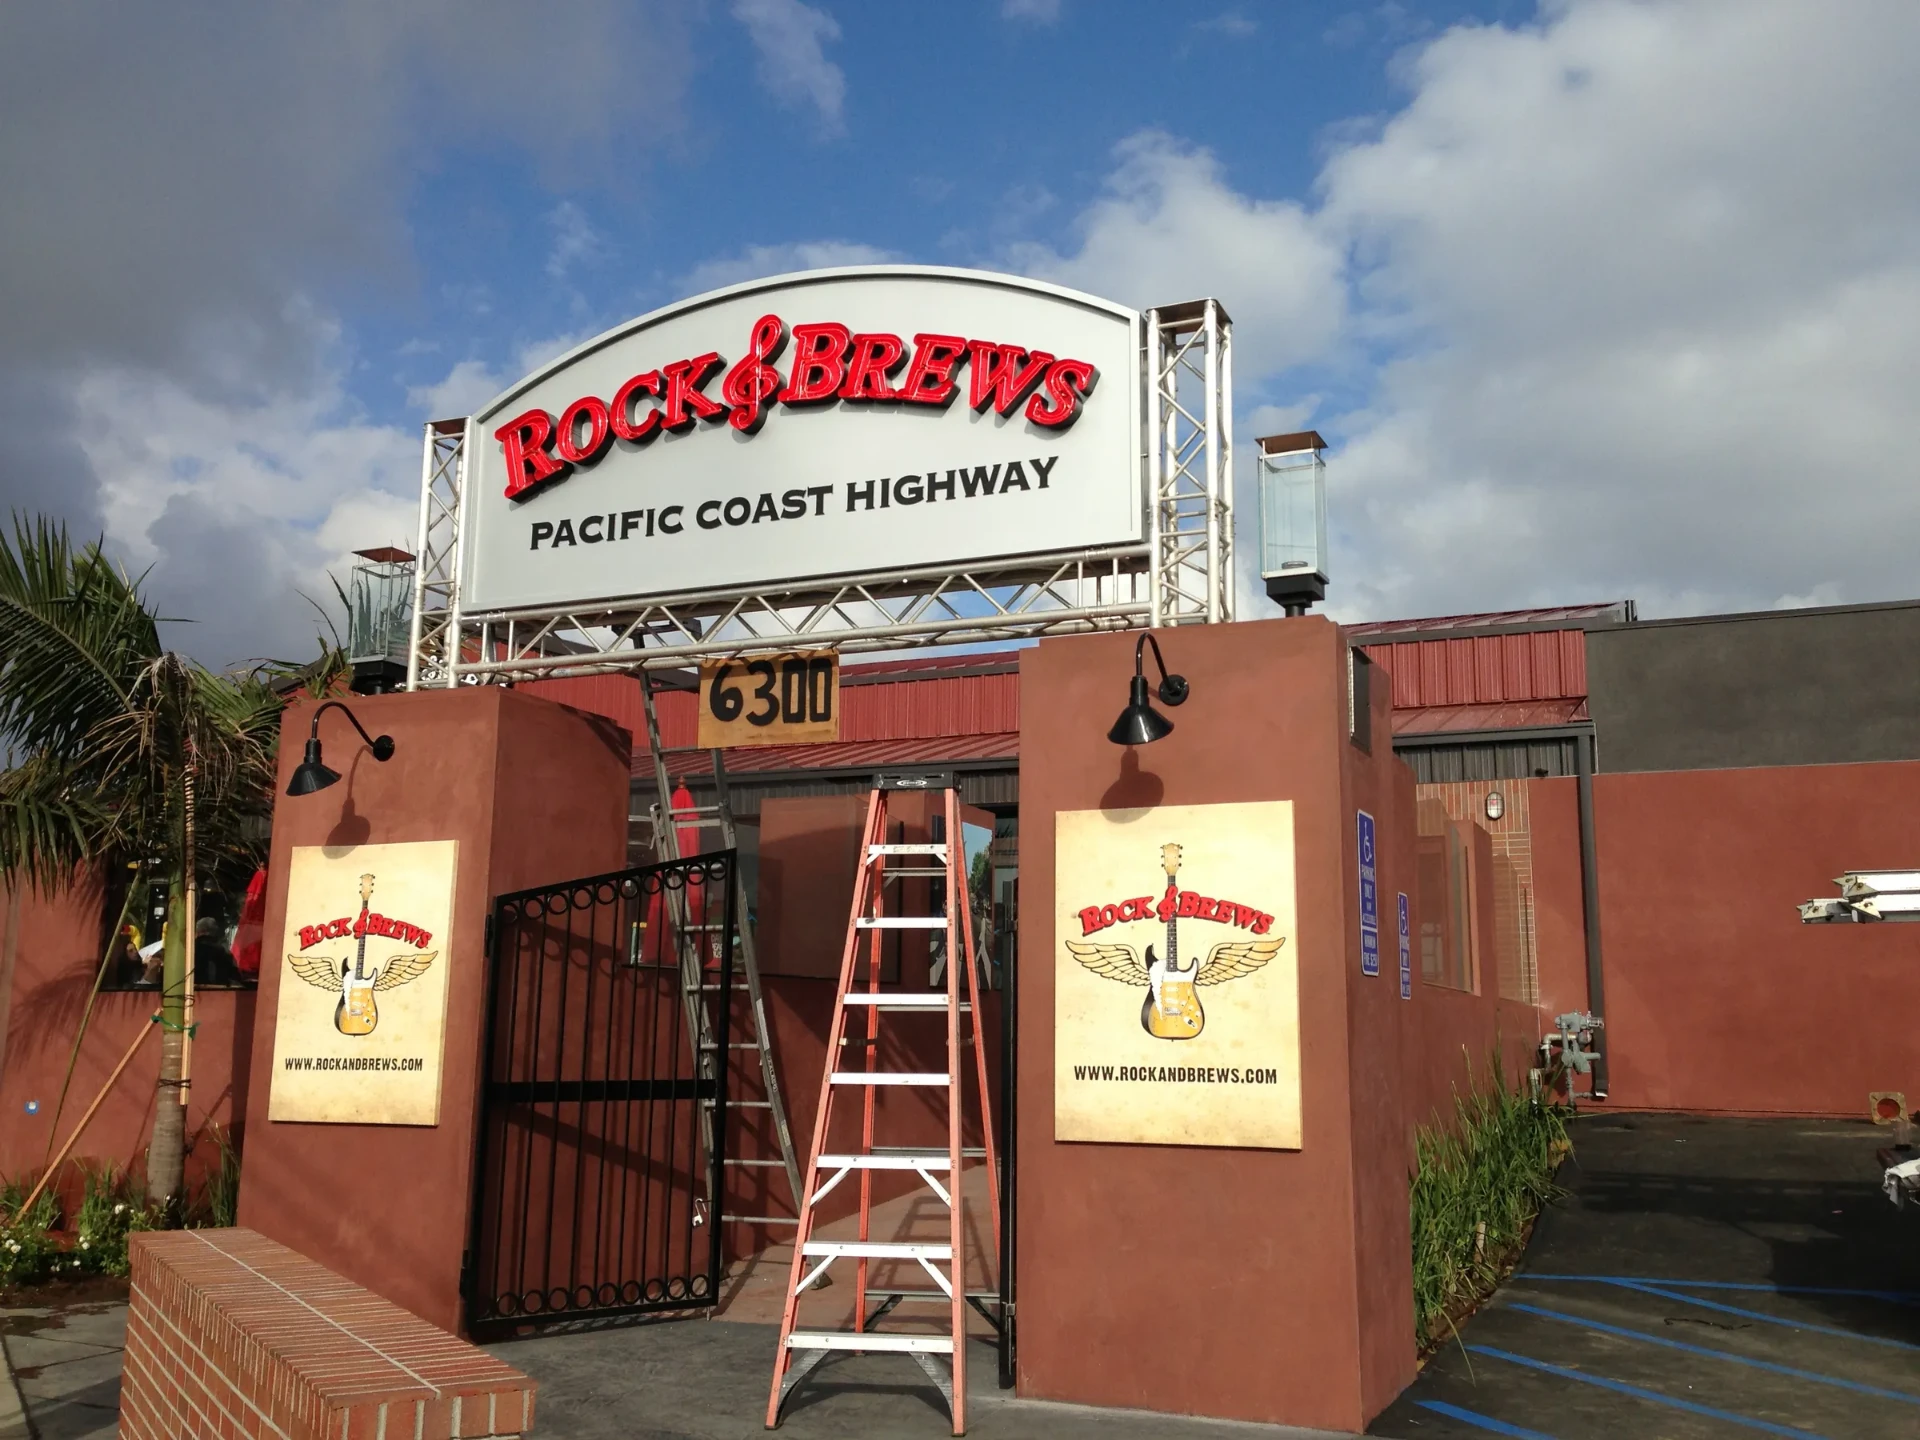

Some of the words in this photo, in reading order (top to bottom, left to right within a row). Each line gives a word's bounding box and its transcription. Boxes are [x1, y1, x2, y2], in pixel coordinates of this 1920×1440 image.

[495, 351, 730, 503] ROCK
[778, 322, 1100, 430] BREWS
[530, 505, 684, 550] PACIFIC
[696, 483, 833, 530] COAST
[846, 455, 1059, 513] HIGHWAY
[709, 658, 833, 726] 6300
[299, 917, 353, 951] ROCK
[366, 913, 433, 949] BREWS
[1079, 896, 1156, 936] ROCK
[1177, 891, 1275, 935] BREWS
[285, 1057, 424, 1072] WWW.ROCKANDBREWS.COM
[1074, 1065, 1278, 1085] WWW.ROCKANDBREWS.COM
